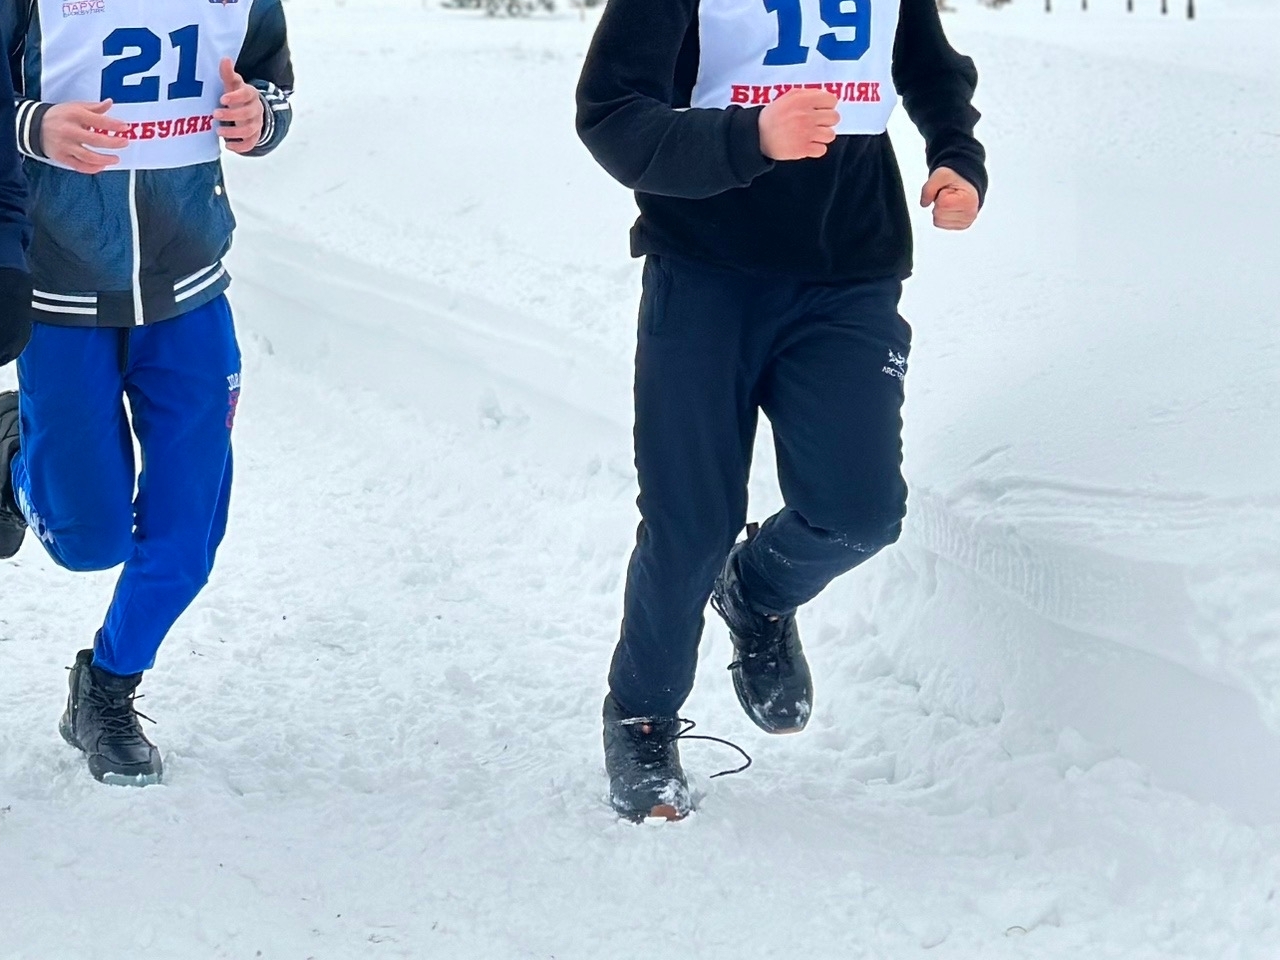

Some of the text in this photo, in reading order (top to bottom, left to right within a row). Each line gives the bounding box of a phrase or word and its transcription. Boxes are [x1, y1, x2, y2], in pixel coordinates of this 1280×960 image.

[62, 0, 105, 13] ПАРУС
[100, 23, 204, 104] 21
[730, 82, 881, 103] БИУЛЯК
[88, 114, 214, 140] ЖБУЛЯК
